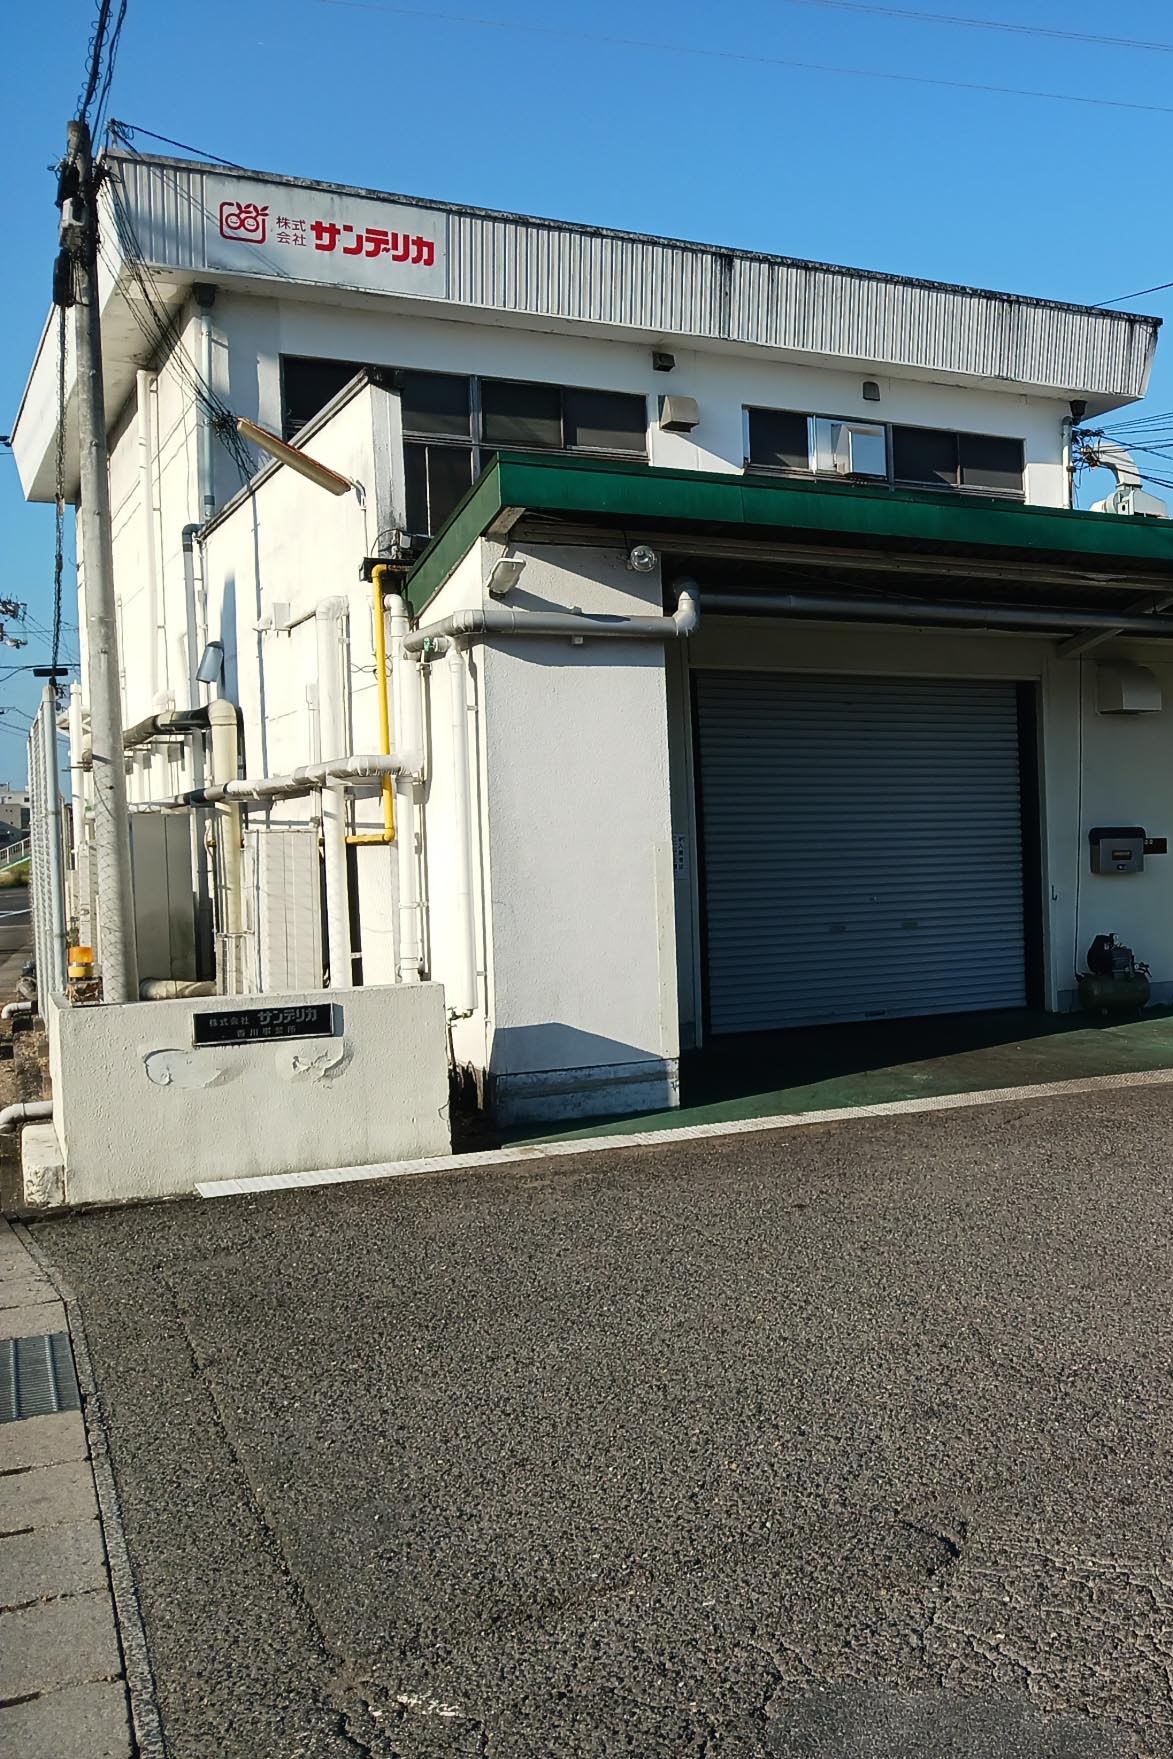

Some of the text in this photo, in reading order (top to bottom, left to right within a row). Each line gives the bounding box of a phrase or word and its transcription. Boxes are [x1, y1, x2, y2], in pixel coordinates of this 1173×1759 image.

[276, 231, 307, 247] 会社
[276, 215, 435, 267] 株式 サンデリカ
[258, 1008, 317, 1024] サンデリカ
